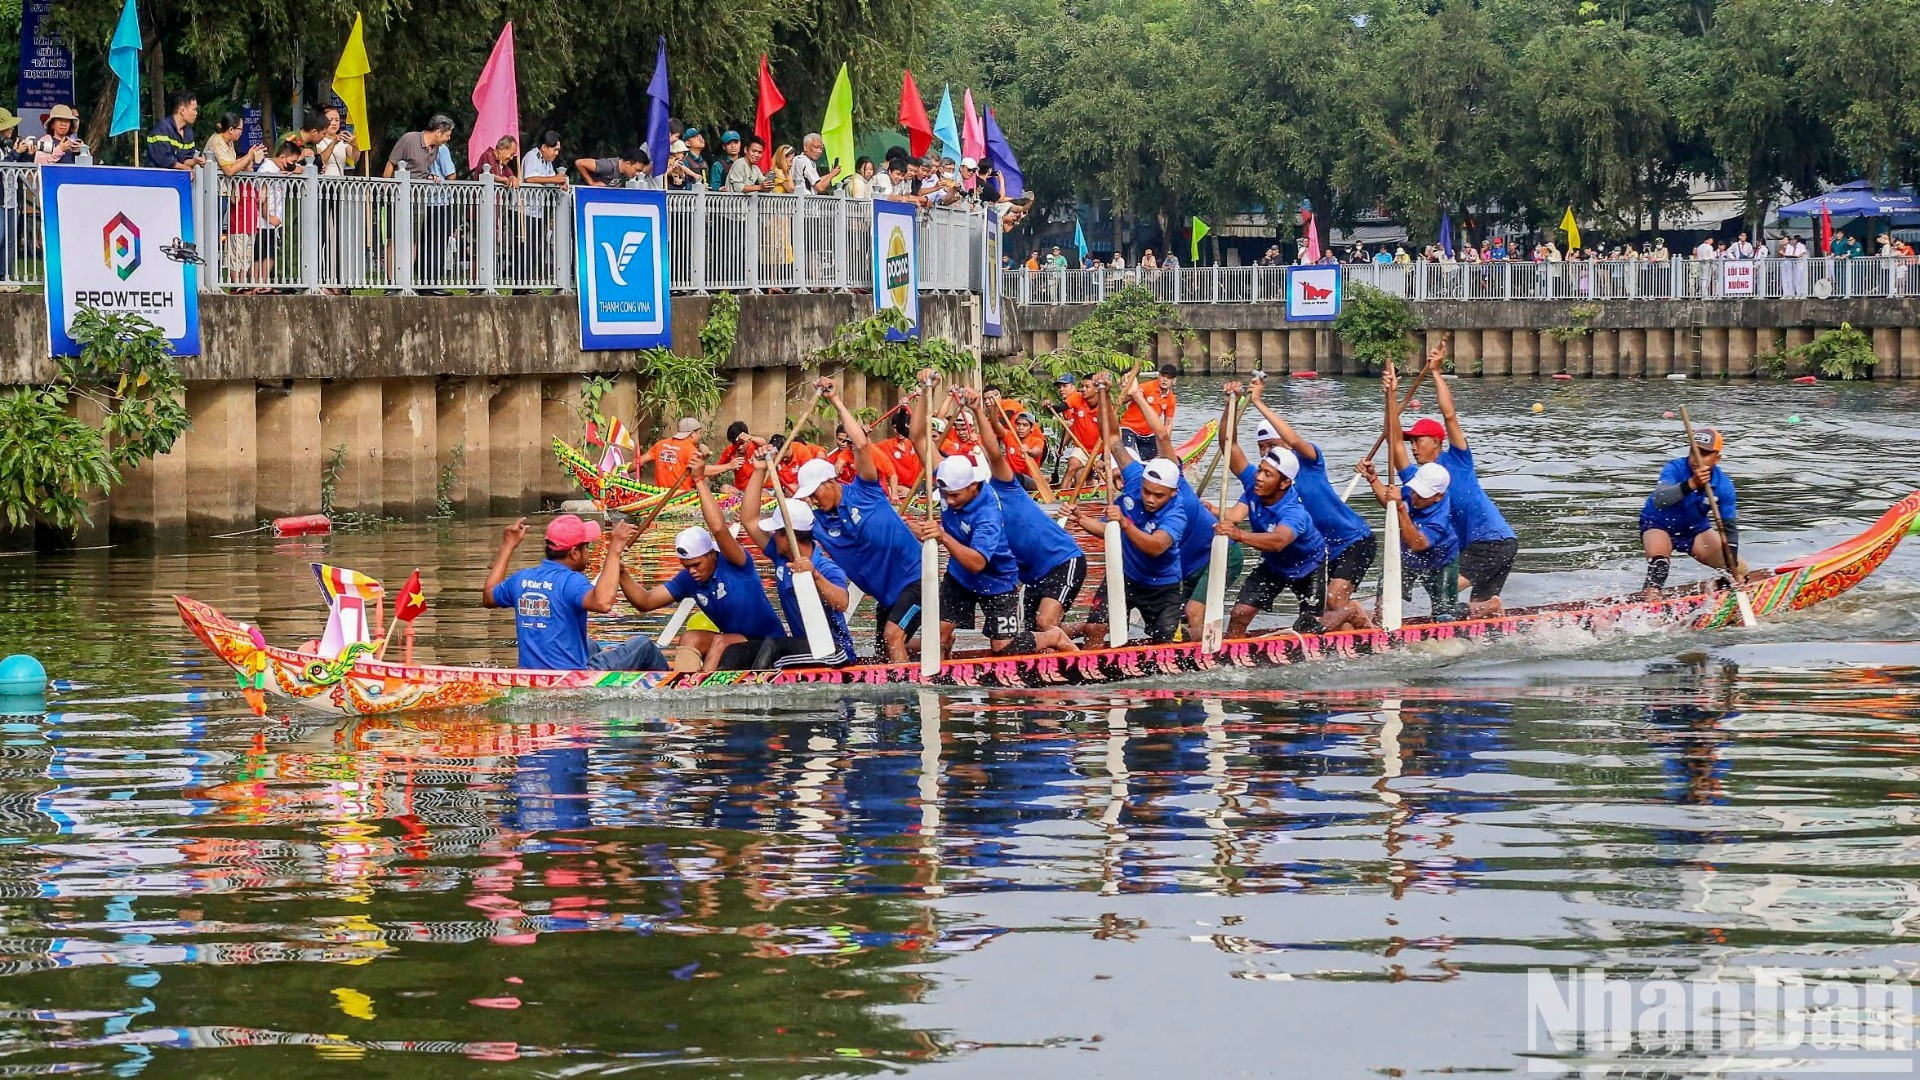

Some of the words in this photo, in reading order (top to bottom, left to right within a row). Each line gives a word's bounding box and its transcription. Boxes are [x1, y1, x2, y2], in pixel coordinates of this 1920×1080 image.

[75, 291, 173, 307] PROWTECH
[598, 301, 619, 313] THANH
[637, 301, 651, 313] VINA
[997, 616, 1017, 634] 29
